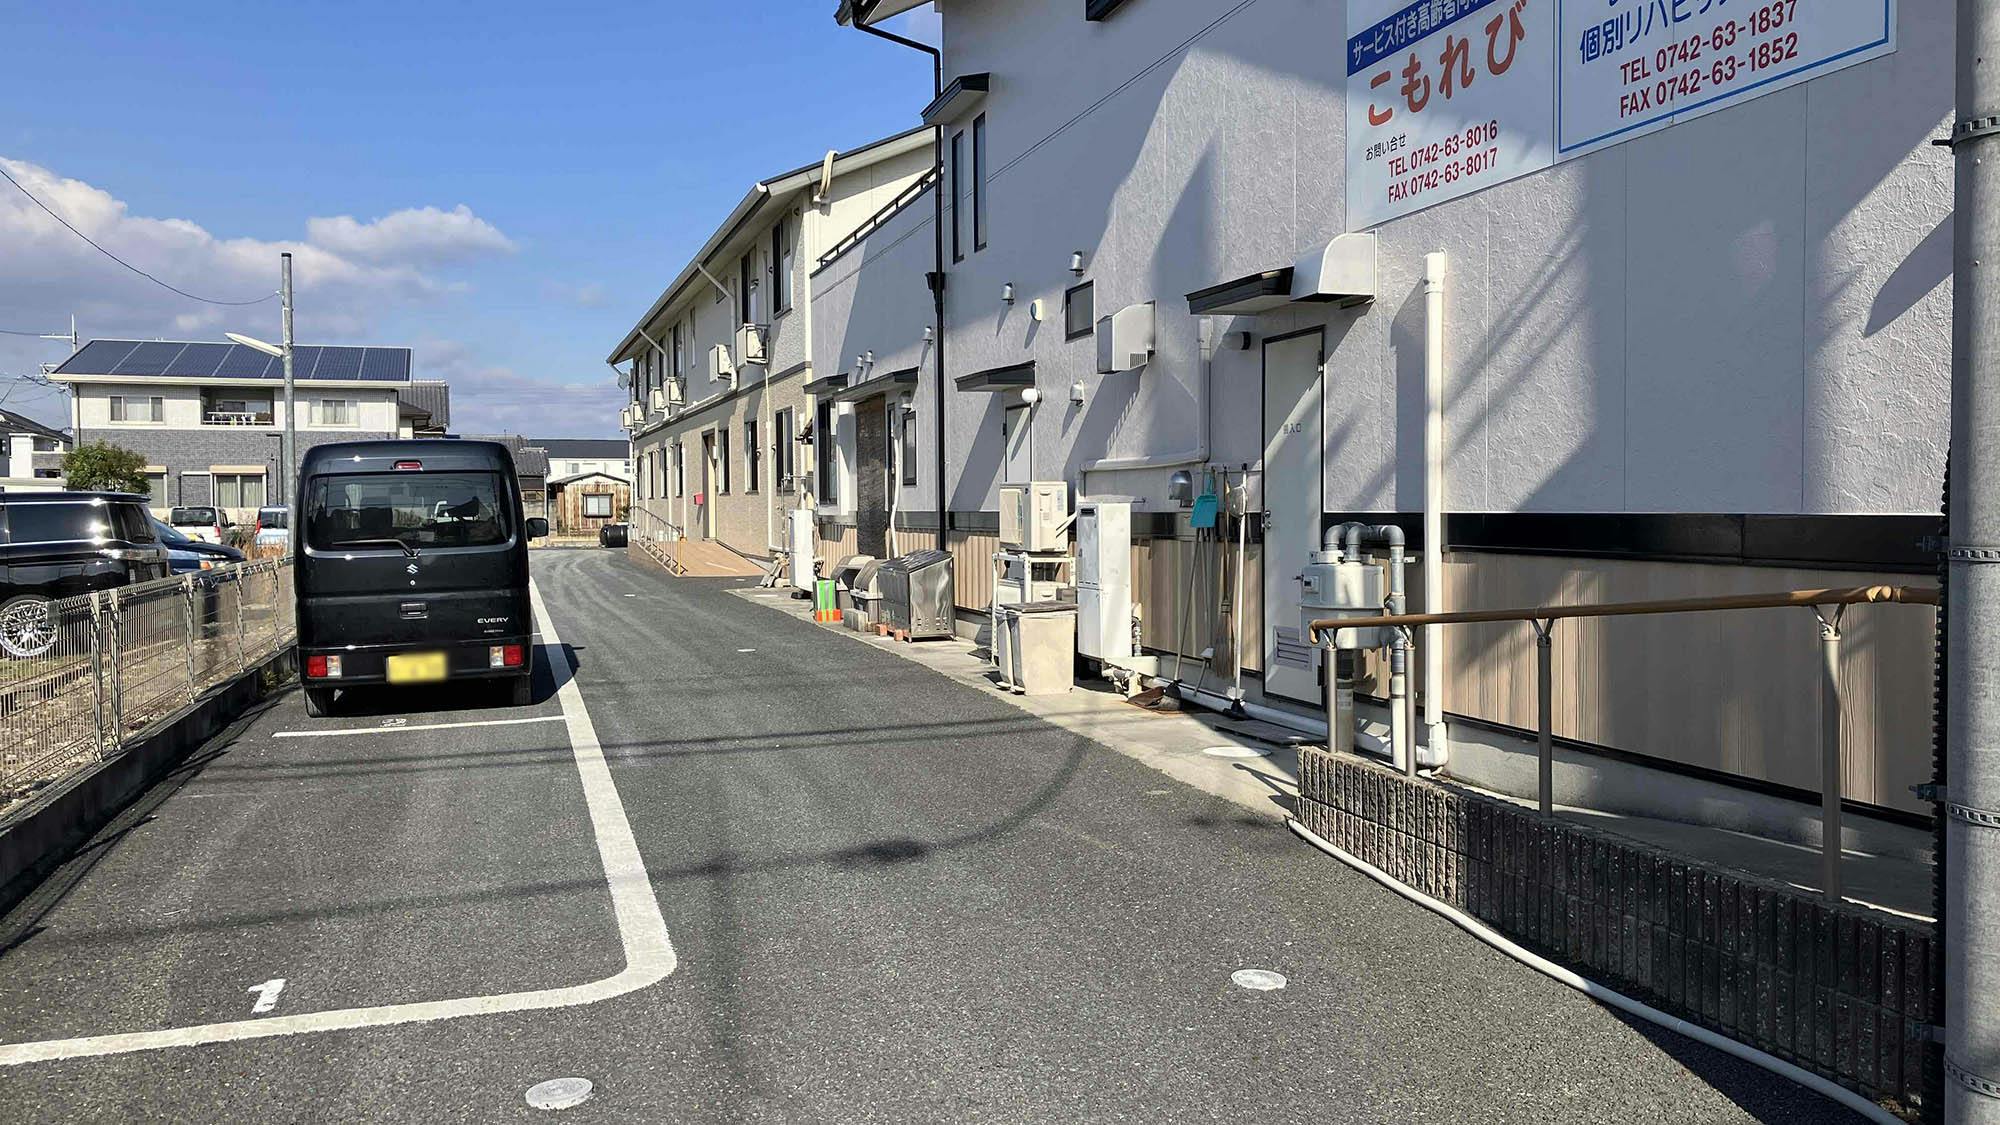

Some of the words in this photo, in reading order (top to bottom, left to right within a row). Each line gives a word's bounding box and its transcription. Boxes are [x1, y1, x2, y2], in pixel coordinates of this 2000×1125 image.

[1352, 0, 1479, 66] サービス付き高齢者
[1368, 0, 1527, 126] こもれび
[1620, 56, 1651, 85] TEL
[1656, 0, 1798, 73] 0742-63-1837
[1620, 86, 1651, 118] FAX
[1656, 32, 1798, 106] 0742-63-1852
[1366, 132, 1407, 160] お問い合せ
[1388, 180, 1408, 203] FAX
[1411, 147, 1498, 195] 0742-63-8017
[1389, 156, 1408, 178] TEL
[1411, 119, 1498, 170] 0742-63-8016
[248, 979, 287, 1014] 1
